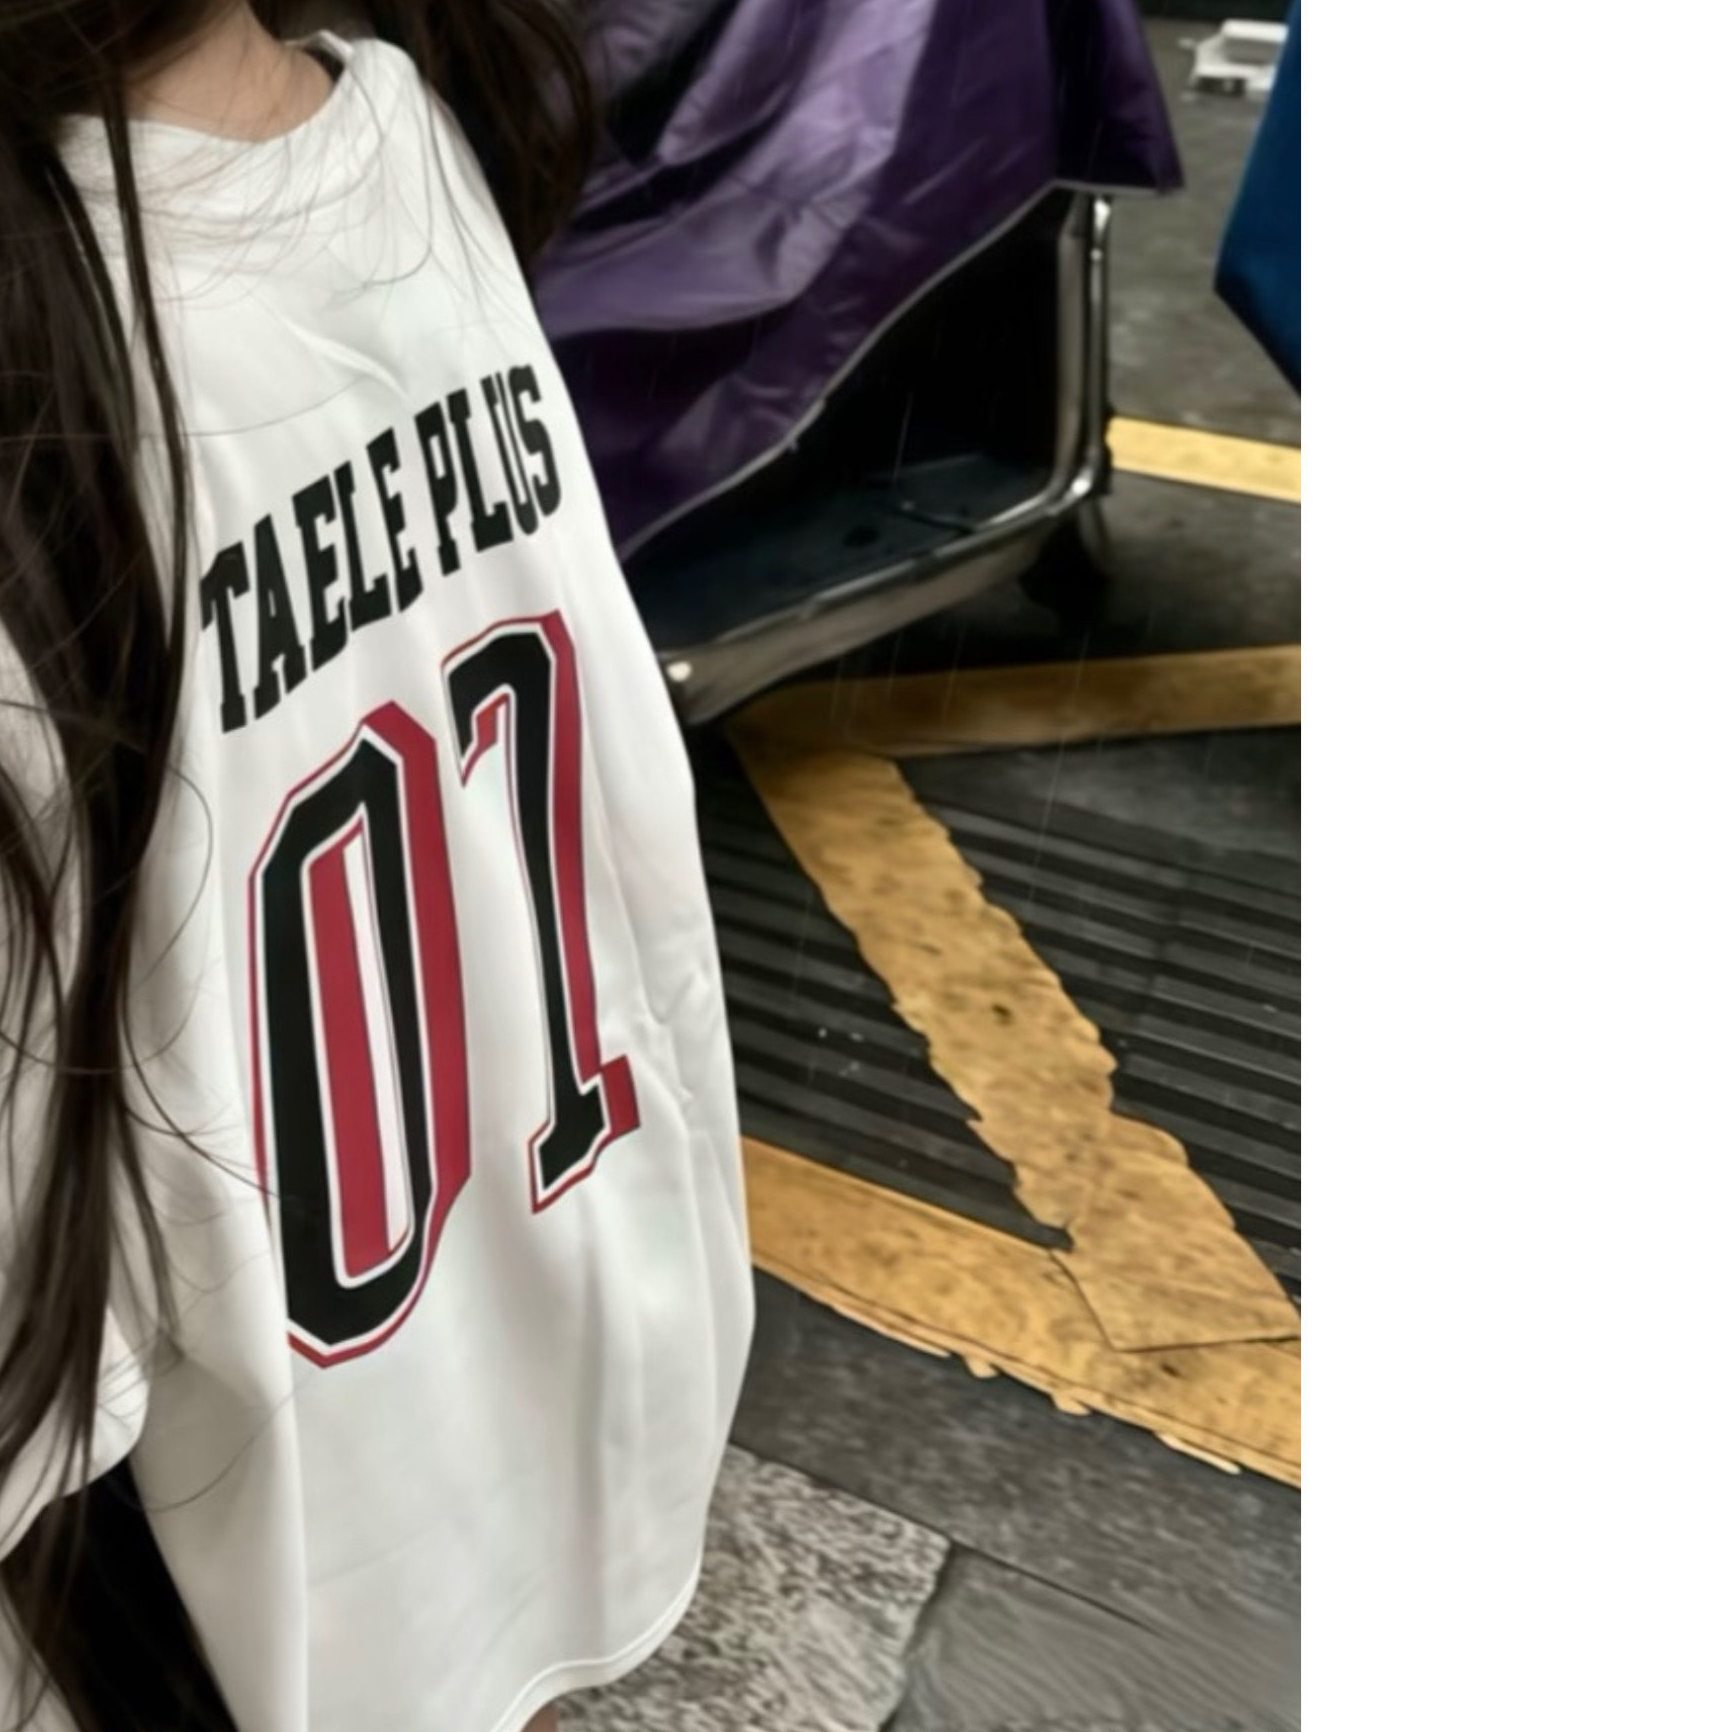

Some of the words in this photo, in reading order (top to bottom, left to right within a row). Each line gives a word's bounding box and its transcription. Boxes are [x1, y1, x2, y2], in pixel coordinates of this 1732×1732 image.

[199, 426, 424, 734] TAELE
[414, 363, 562, 577] PLUS
[248, 609, 641, 1369] 07
